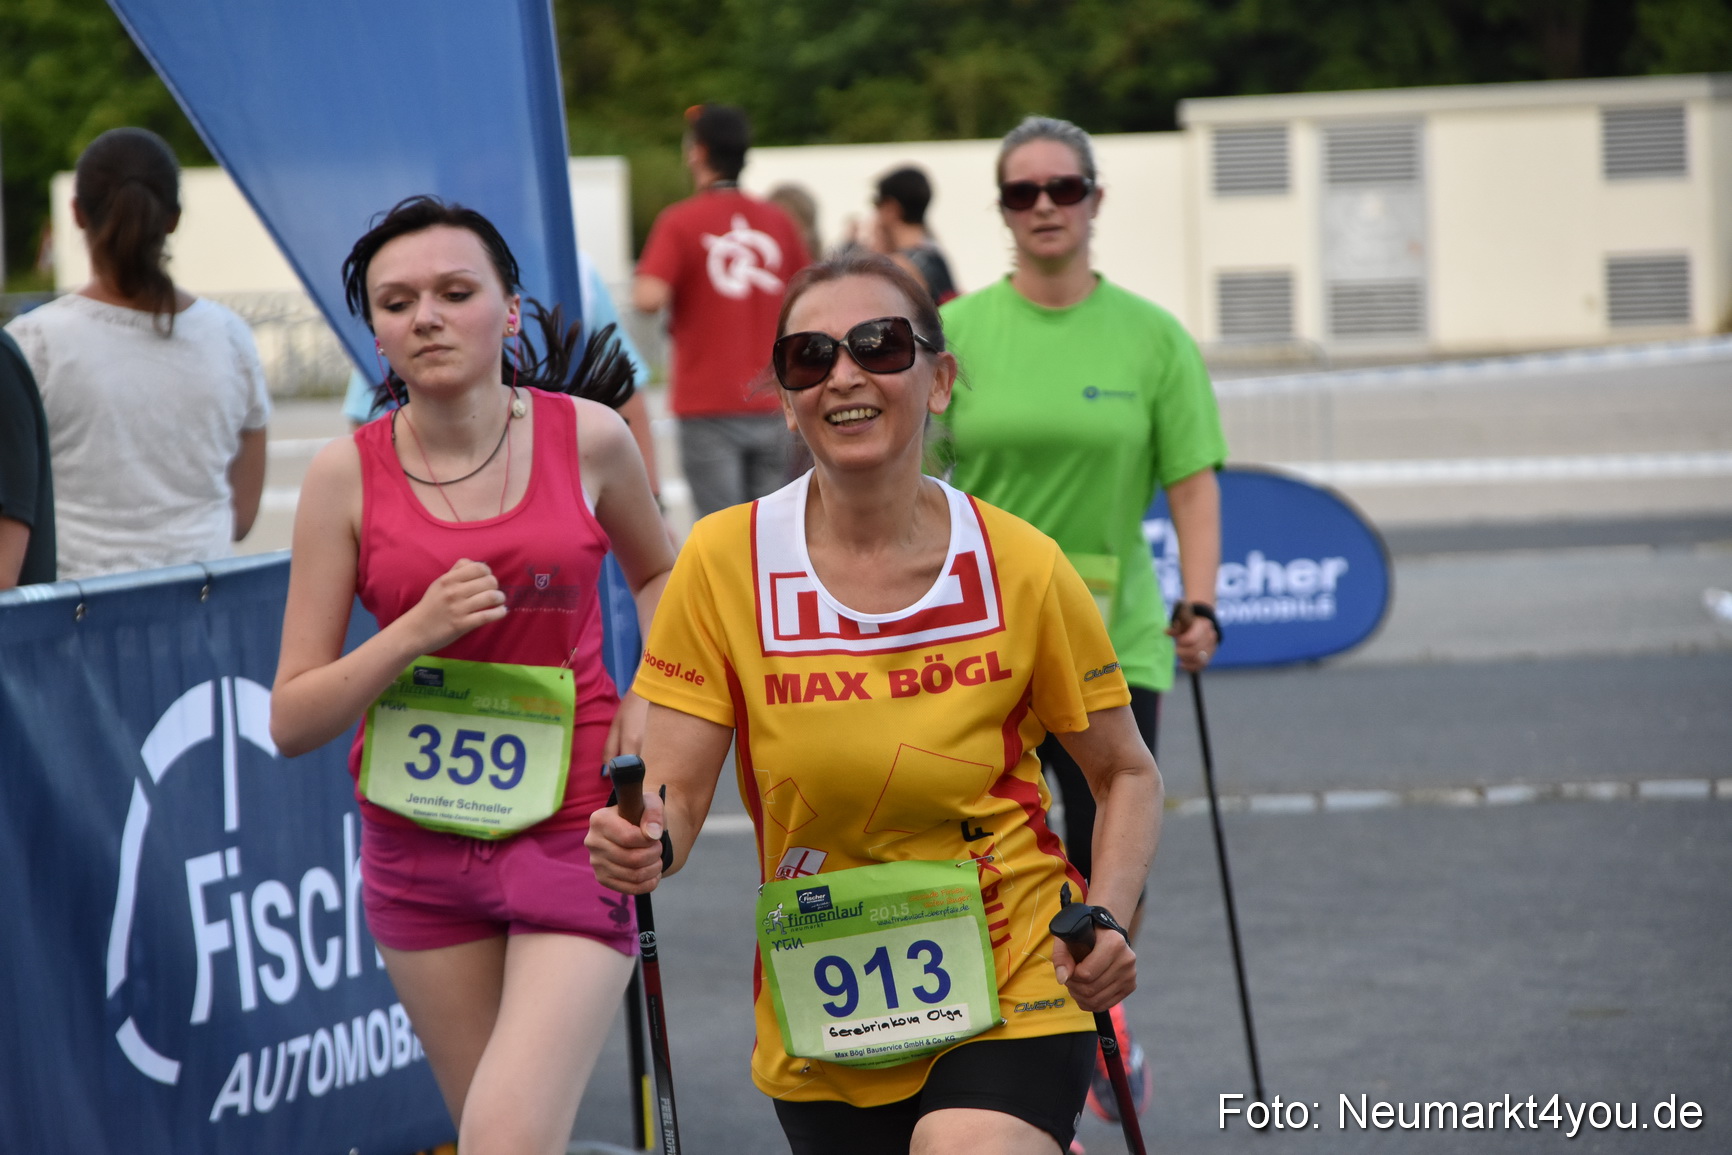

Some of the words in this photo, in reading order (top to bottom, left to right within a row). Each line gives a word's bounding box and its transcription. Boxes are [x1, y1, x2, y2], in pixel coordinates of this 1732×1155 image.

[765, 671, 873, 706] MAX
[889, 651, 1013, 700] BÖGL
[404, 723, 527, 791] 359
[405, 793, 454, 808] Jennifer
[456, 798, 513, 815] Schneller
[788, 901, 864, 927] firmenlauf
[869, 902, 910, 922] 2015
[813, 939, 951, 1018] 913
[926, 1008, 963, 1021] Olga
[849, 1047, 866, 1057] Bögl
[866, 1044, 903, 1054] Bauservice
[904, 1040, 925, 1049] GmbH
[925, 1038, 932, 1046] &
